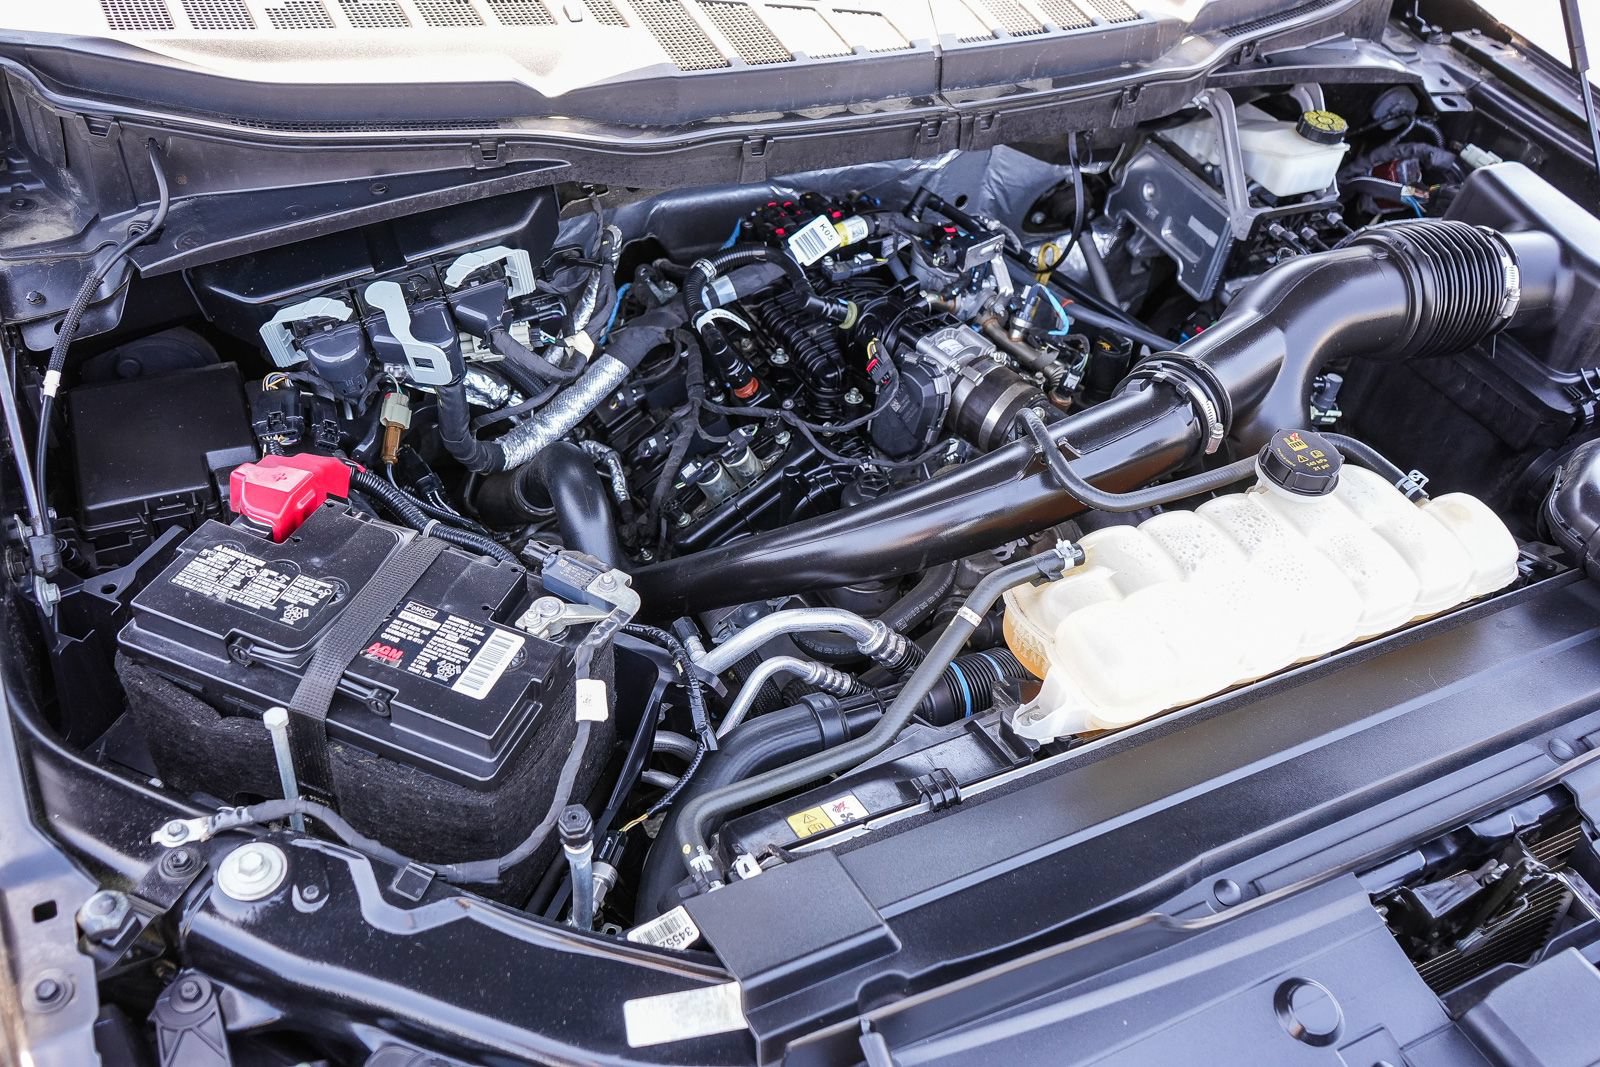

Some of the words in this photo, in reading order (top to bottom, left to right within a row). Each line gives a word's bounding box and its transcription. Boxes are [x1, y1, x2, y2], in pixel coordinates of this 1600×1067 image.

[819, 223, 833, 241] K05
[406, 603, 435, 616] FoMoCo
[367, 642, 404, 661] AGM
